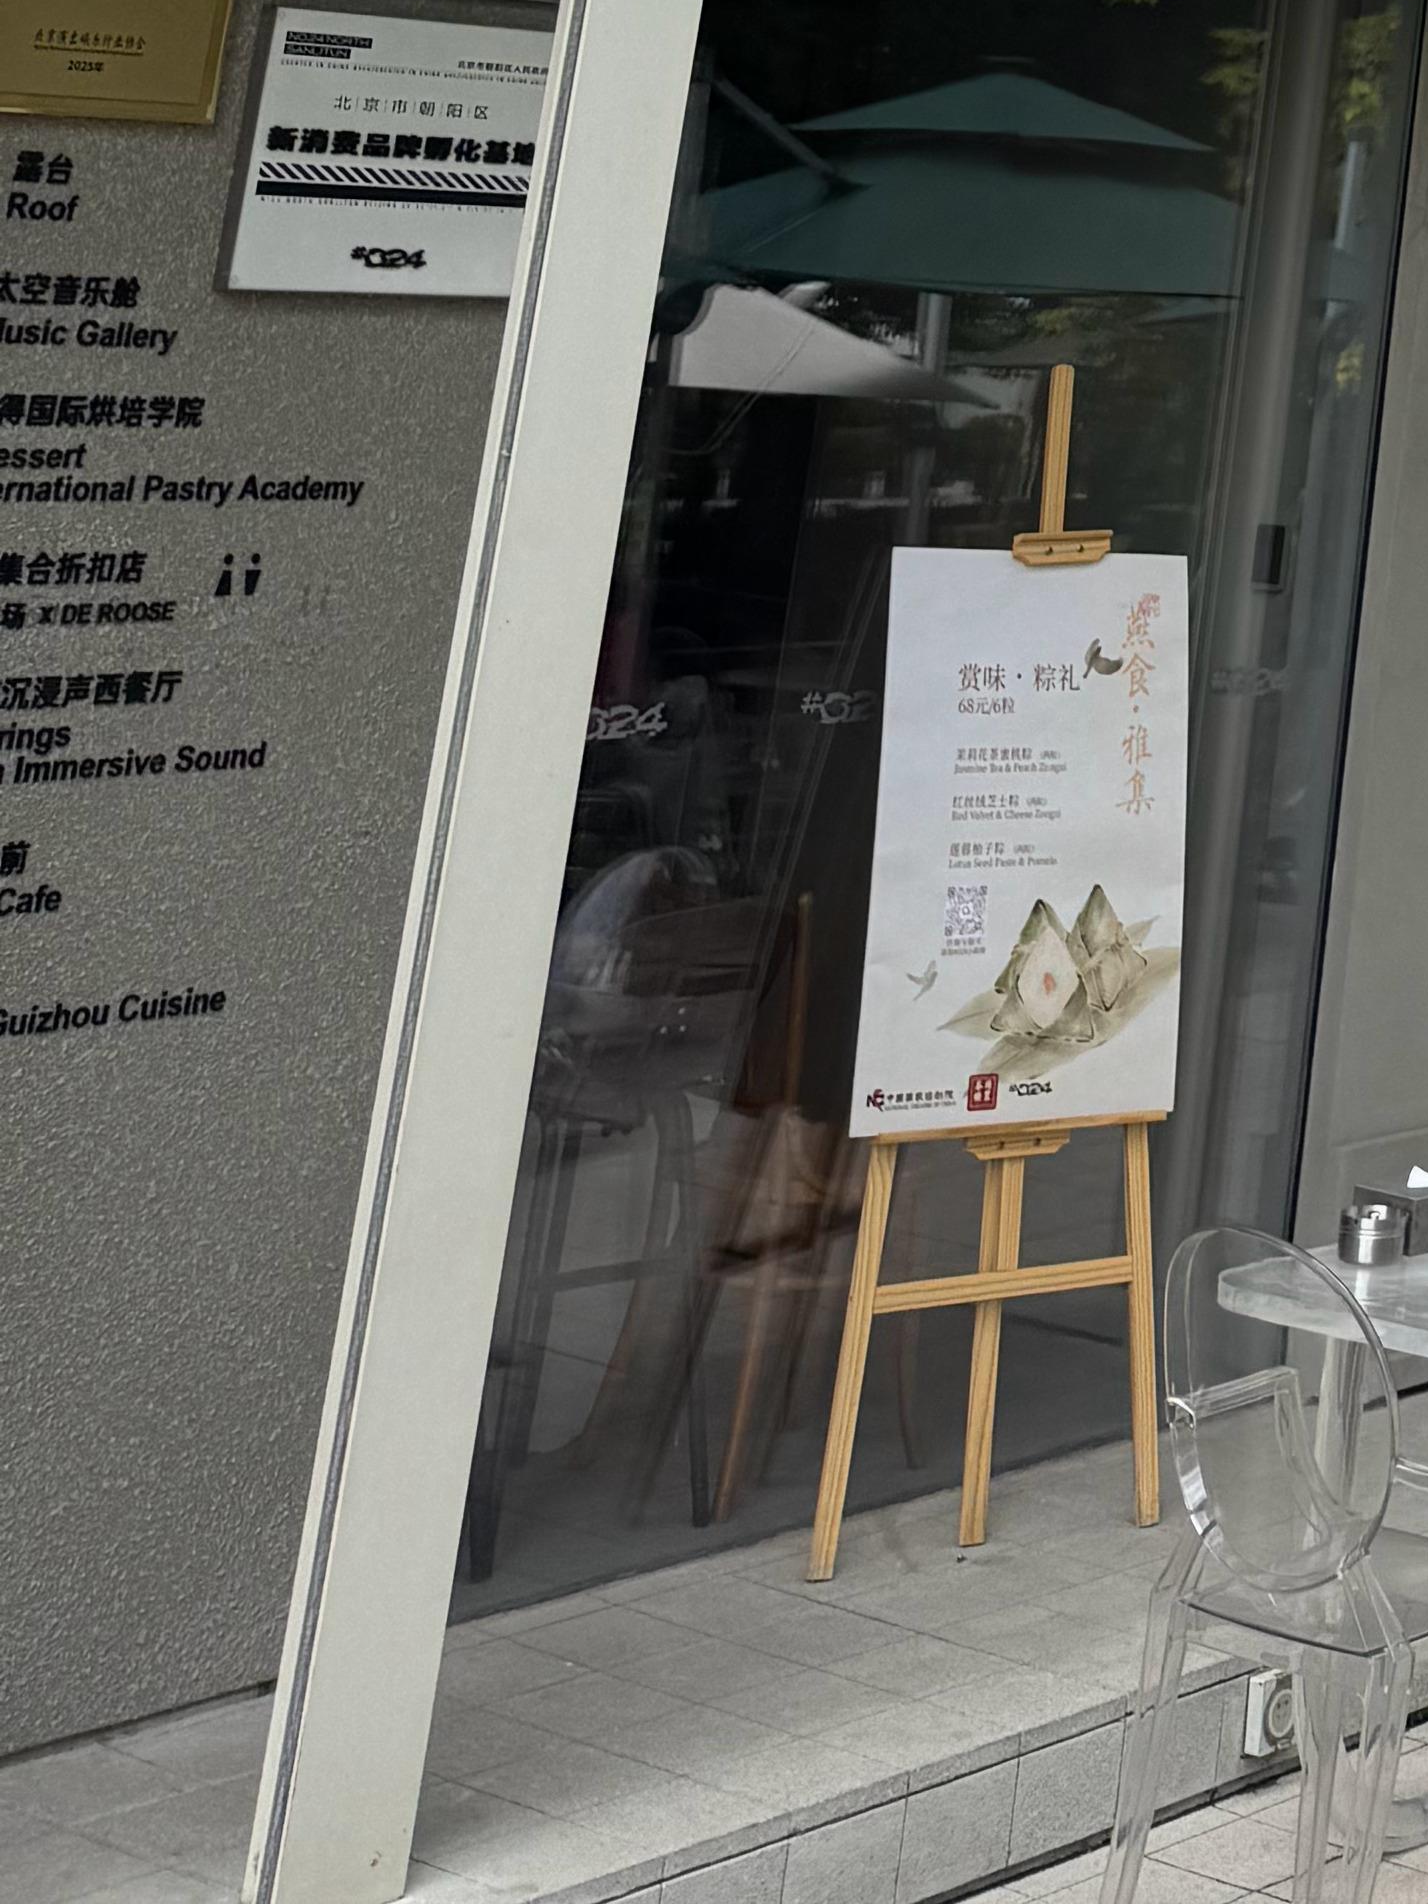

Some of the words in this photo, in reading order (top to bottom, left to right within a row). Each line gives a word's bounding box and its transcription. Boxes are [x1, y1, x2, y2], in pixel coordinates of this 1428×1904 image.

[12, 150, 74, 185] 露台
[6, 192, 80, 222] Roof
[0, 316, 68, 347] usic
[76, 319, 178, 356] Gallery
[143, 475, 233, 508] Pastry
[237, 474, 365, 507] Academy
[60, 603, 93, 625] DE
[99, 600, 177, 625] ROOSE
[13, 748, 166, 785] Immersive
[174, 741, 267, 774] Sound
[0, 884, 62, 917] Cafe
[118, 987, 226, 1023] Cuisine
